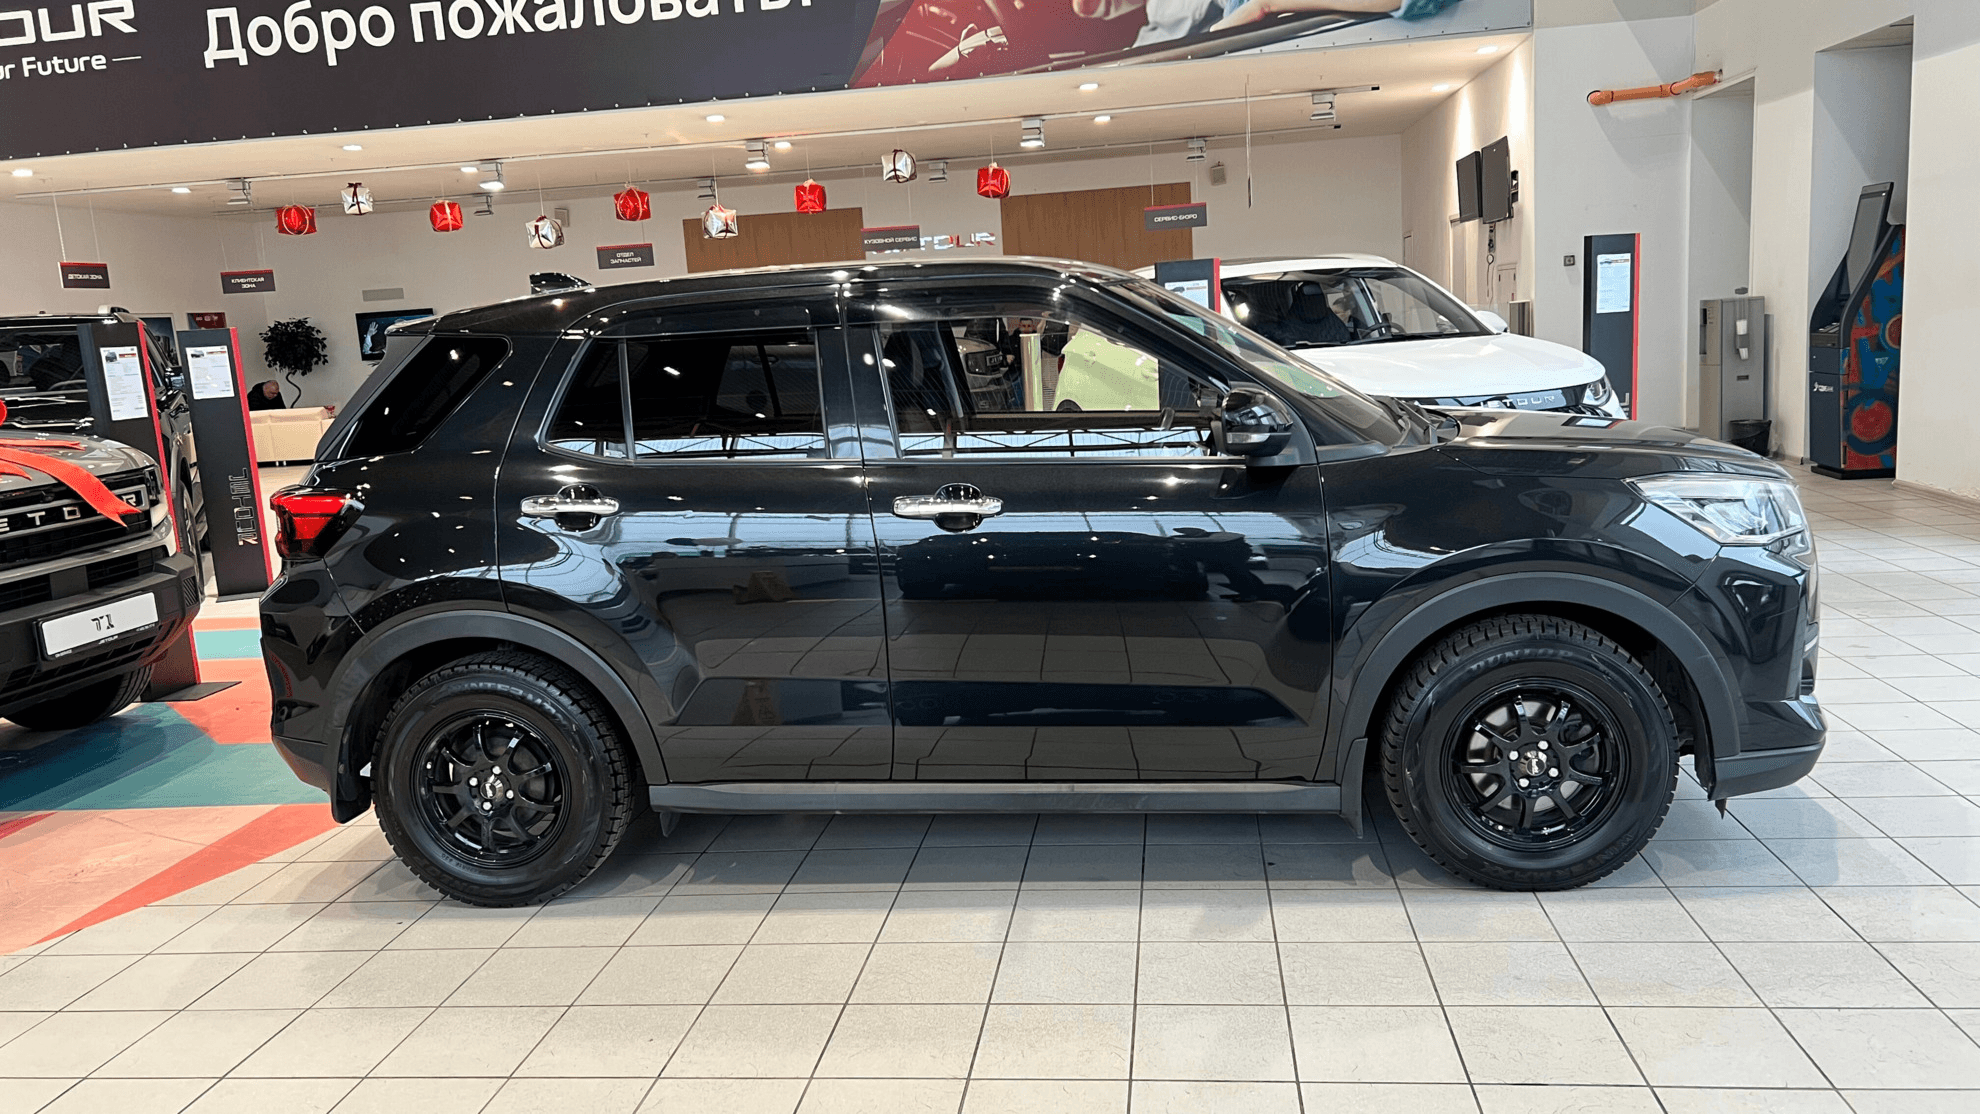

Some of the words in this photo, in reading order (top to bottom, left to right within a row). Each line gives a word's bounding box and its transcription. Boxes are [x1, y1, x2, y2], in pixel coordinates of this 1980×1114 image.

[203, 0, 395, 68] Добро
[410, 0, 812, 42] пожалов
[21, 54, 107, 78] Future
[1154, 213, 1198, 222] СЕРВИС-БЮРО
[0, 493, 137, 532] ETOR
